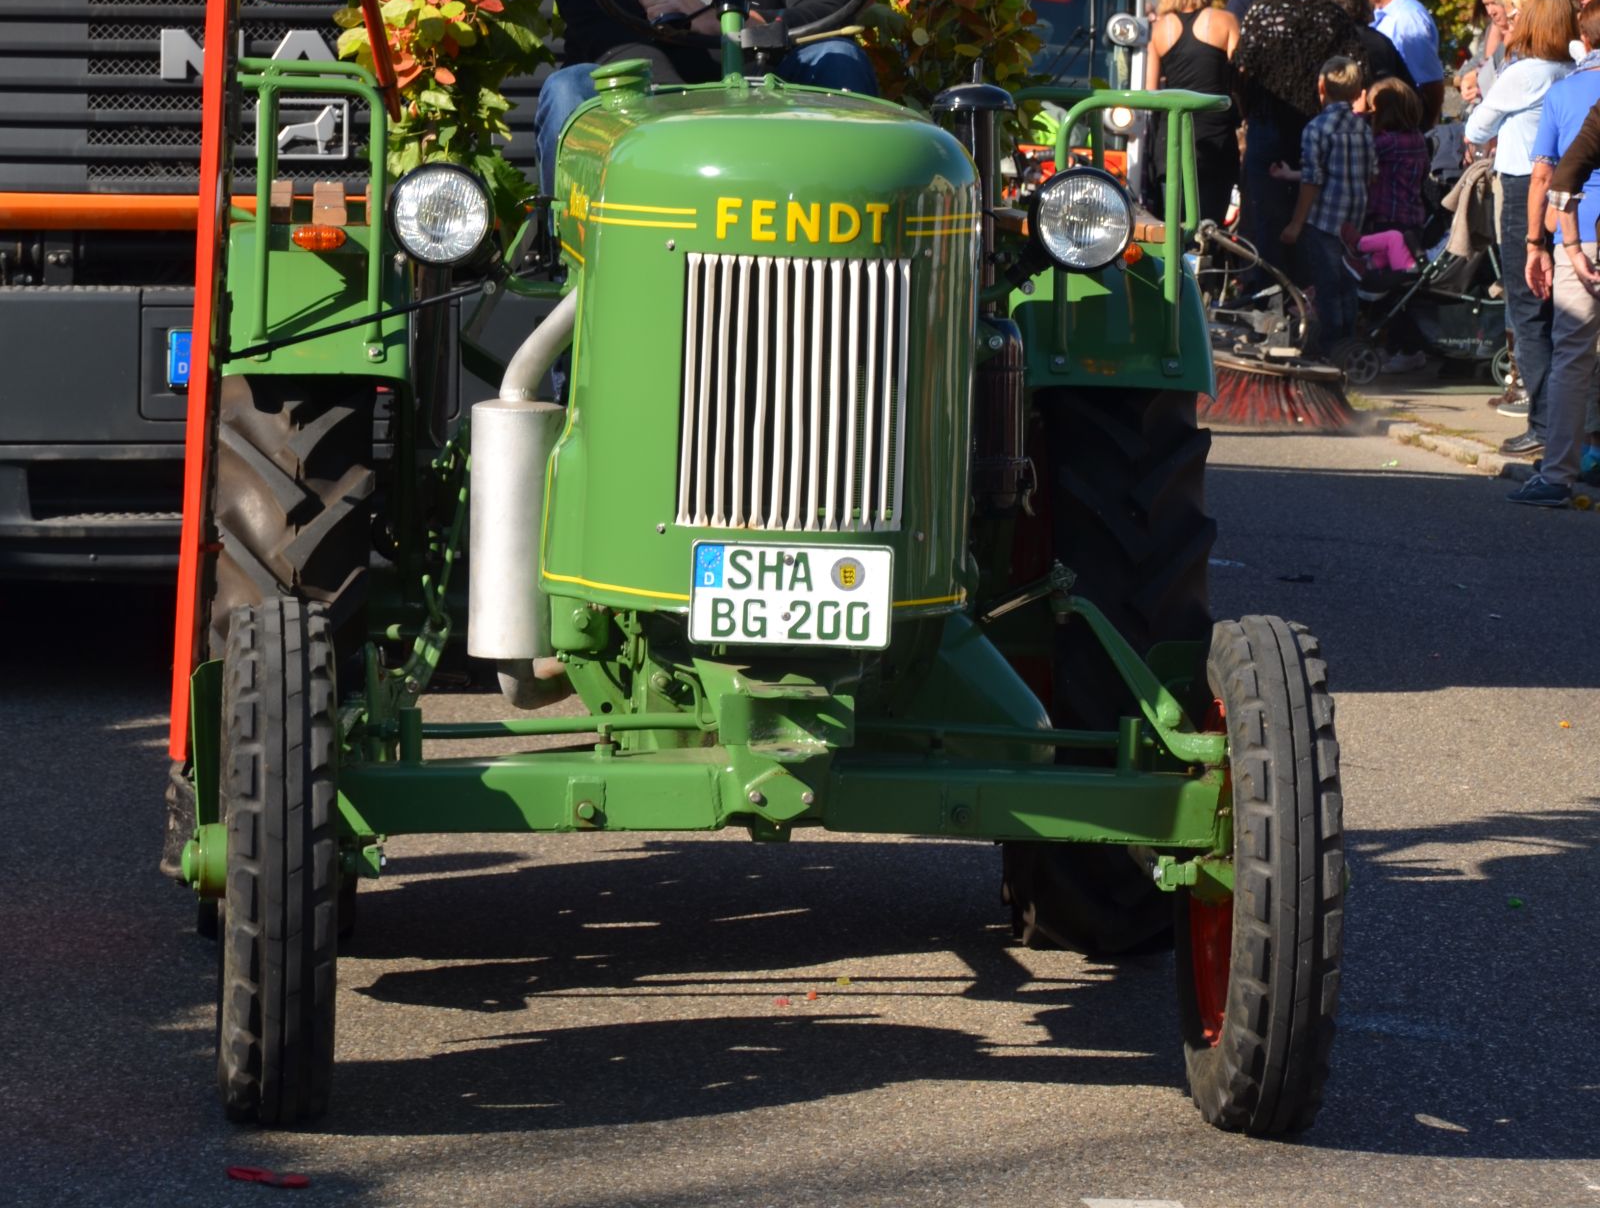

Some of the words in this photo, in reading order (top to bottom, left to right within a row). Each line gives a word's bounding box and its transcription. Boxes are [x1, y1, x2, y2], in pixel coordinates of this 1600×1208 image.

[716, 196, 890, 245] FENDT
[178, 361, 189, 374] D
[703, 571, 715, 585] D
[727, 549, 814, 592] SHA
[710, 597, 768, 638] BG
[787, 600, 870, 641] 200
